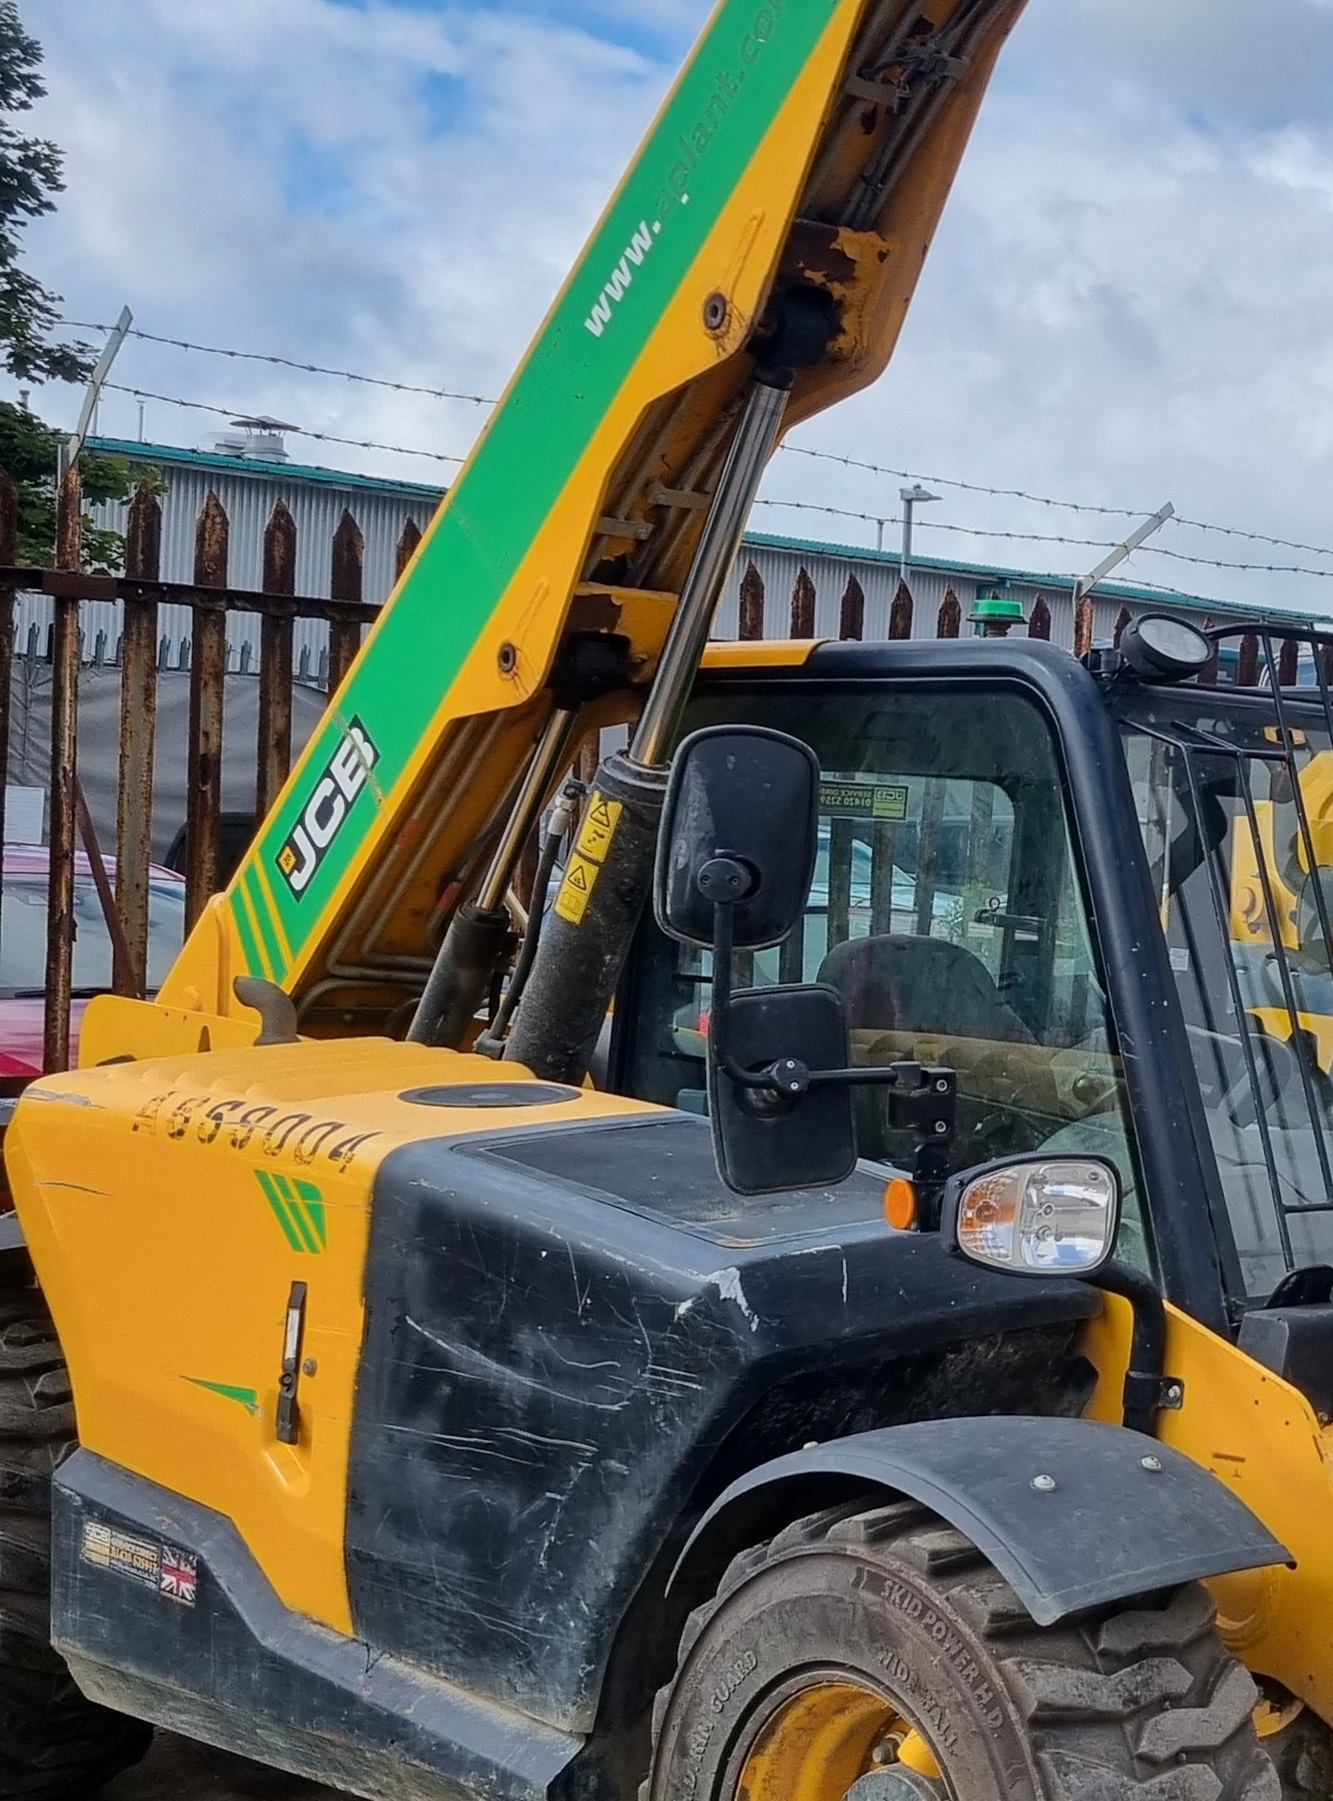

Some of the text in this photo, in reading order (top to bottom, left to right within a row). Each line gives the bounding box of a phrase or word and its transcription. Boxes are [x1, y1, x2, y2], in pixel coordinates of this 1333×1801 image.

[289, 727, 374, 890] JCB
[710, 1649, 759, 1714] GUARD
[882, 1578, 924, 1619] SKID
[923, 1609, 982, 1692] POWER
